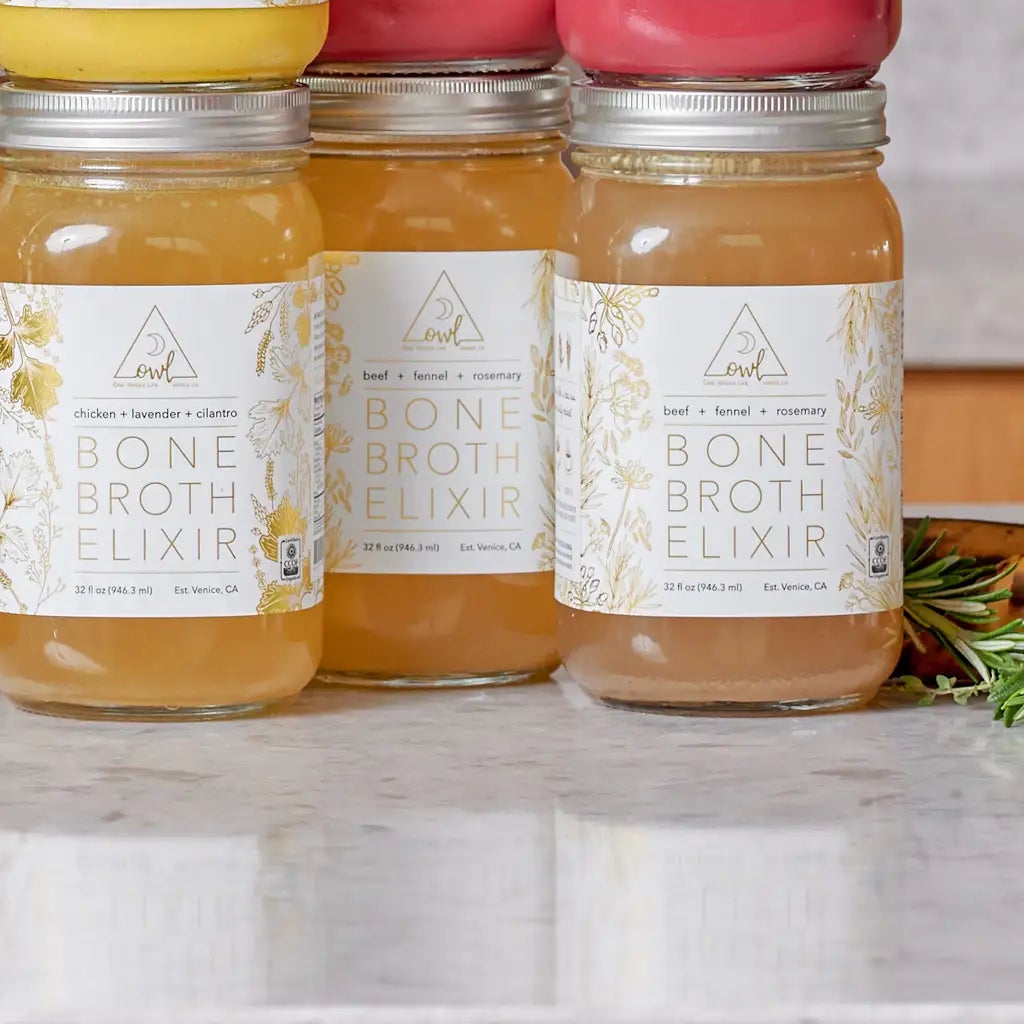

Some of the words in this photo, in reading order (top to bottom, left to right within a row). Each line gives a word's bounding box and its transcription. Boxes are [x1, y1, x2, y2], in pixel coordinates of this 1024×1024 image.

[424, 315, 462, 346] owl
[135, 350, 175, 382] owl
[363, 370, 388, 381] beef
[414, 371, 448, 381] fennel
[473, 372, 521, 382] rosemary
[726, 348, 765, 381] owl
[74, 408, 115, 418] chicken
[132, 408, 181, 419] lavender
[196, 408, 237, 418] cilantro
[367, 398, 520, 430] BONE
[664, 406, 689, 416] beef
[716, 406, 750, 416] fennel
[777, 407, 826, 417] rosemary
[78, 436, 236, 469] BONE
[367, 442, 519, 475] BROTH
[668, 434, 825, 467] BONE
[78, 482, 234, 515] BROTH
[367, 487, 519, 519] ELIXIR
[668, 479, 823, 513] BROTH
[79, 528, 236, 560] ELIXIR
[669, 525, 825, 558] ELIXIR
[75, 586, 85, 594] 32
[89, 586, 93, 594] fl
[108, 586, 136, 595] (946.3
[139, 586, 152, 595] ml)
[175, 586, 189, 594] Est.
[192, 586, 223, 594] Venice,
[226, 585, 238, 593] CA
[664, 583, 675, 591] 32
[678, 583, 682, 591] fl
[697, 583, 725, 592] (946.3
[728, 583, 742, 592] ml)
[764, 583, 779, 591] Est.
[781, 583, 812, 591] Venice,
[814, 582, 827, 590] CA
